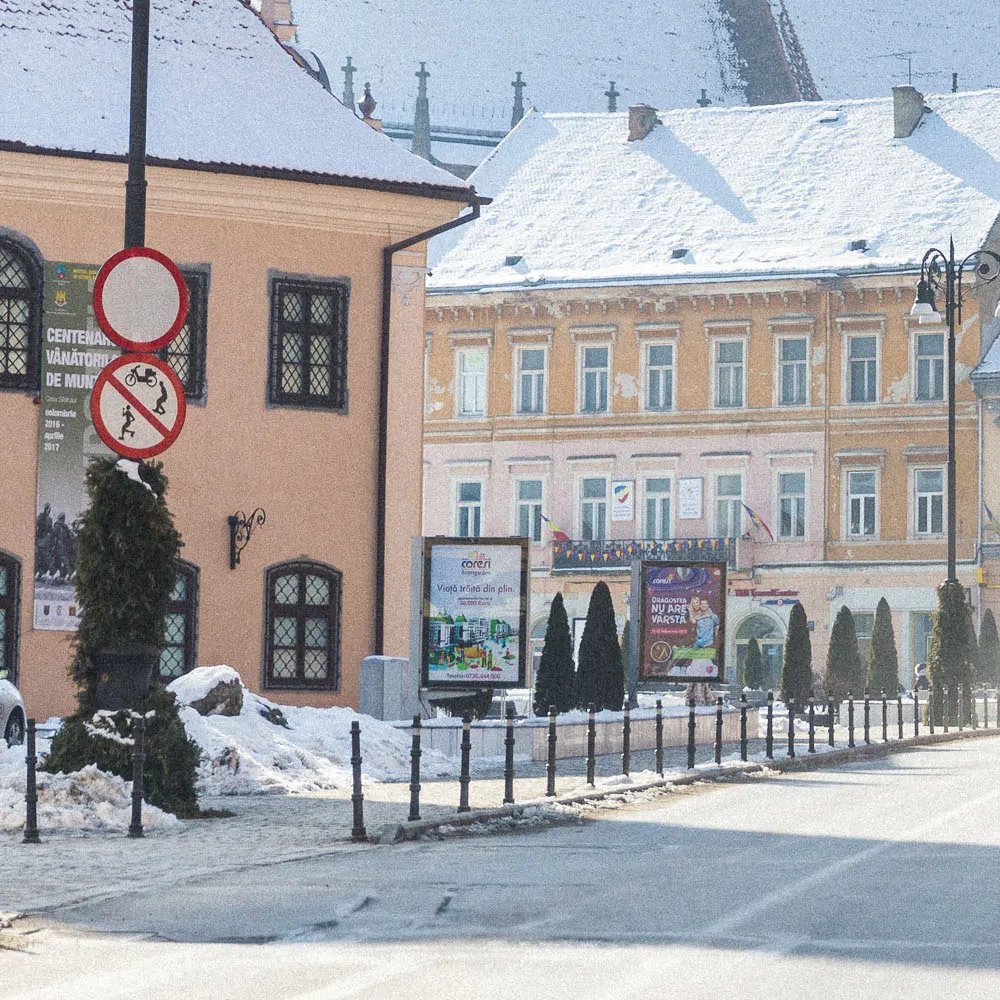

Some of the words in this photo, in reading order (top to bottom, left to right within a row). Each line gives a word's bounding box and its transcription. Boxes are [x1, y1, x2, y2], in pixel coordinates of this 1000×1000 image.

[46, 327, 117, 347] CENTENAR
[45, 346, 118, 369] VÂNĂTORIL
[46, 371, 62, 387] DE
[45, 420, 60, 429] 2016
[44, 442, 60, 451] 2017
[461, 560, 491, 569] coresi
[483, 584, 496, 593] din
[651, 603, 666, 613] NU
[667, 604, 688, 614] ARE
